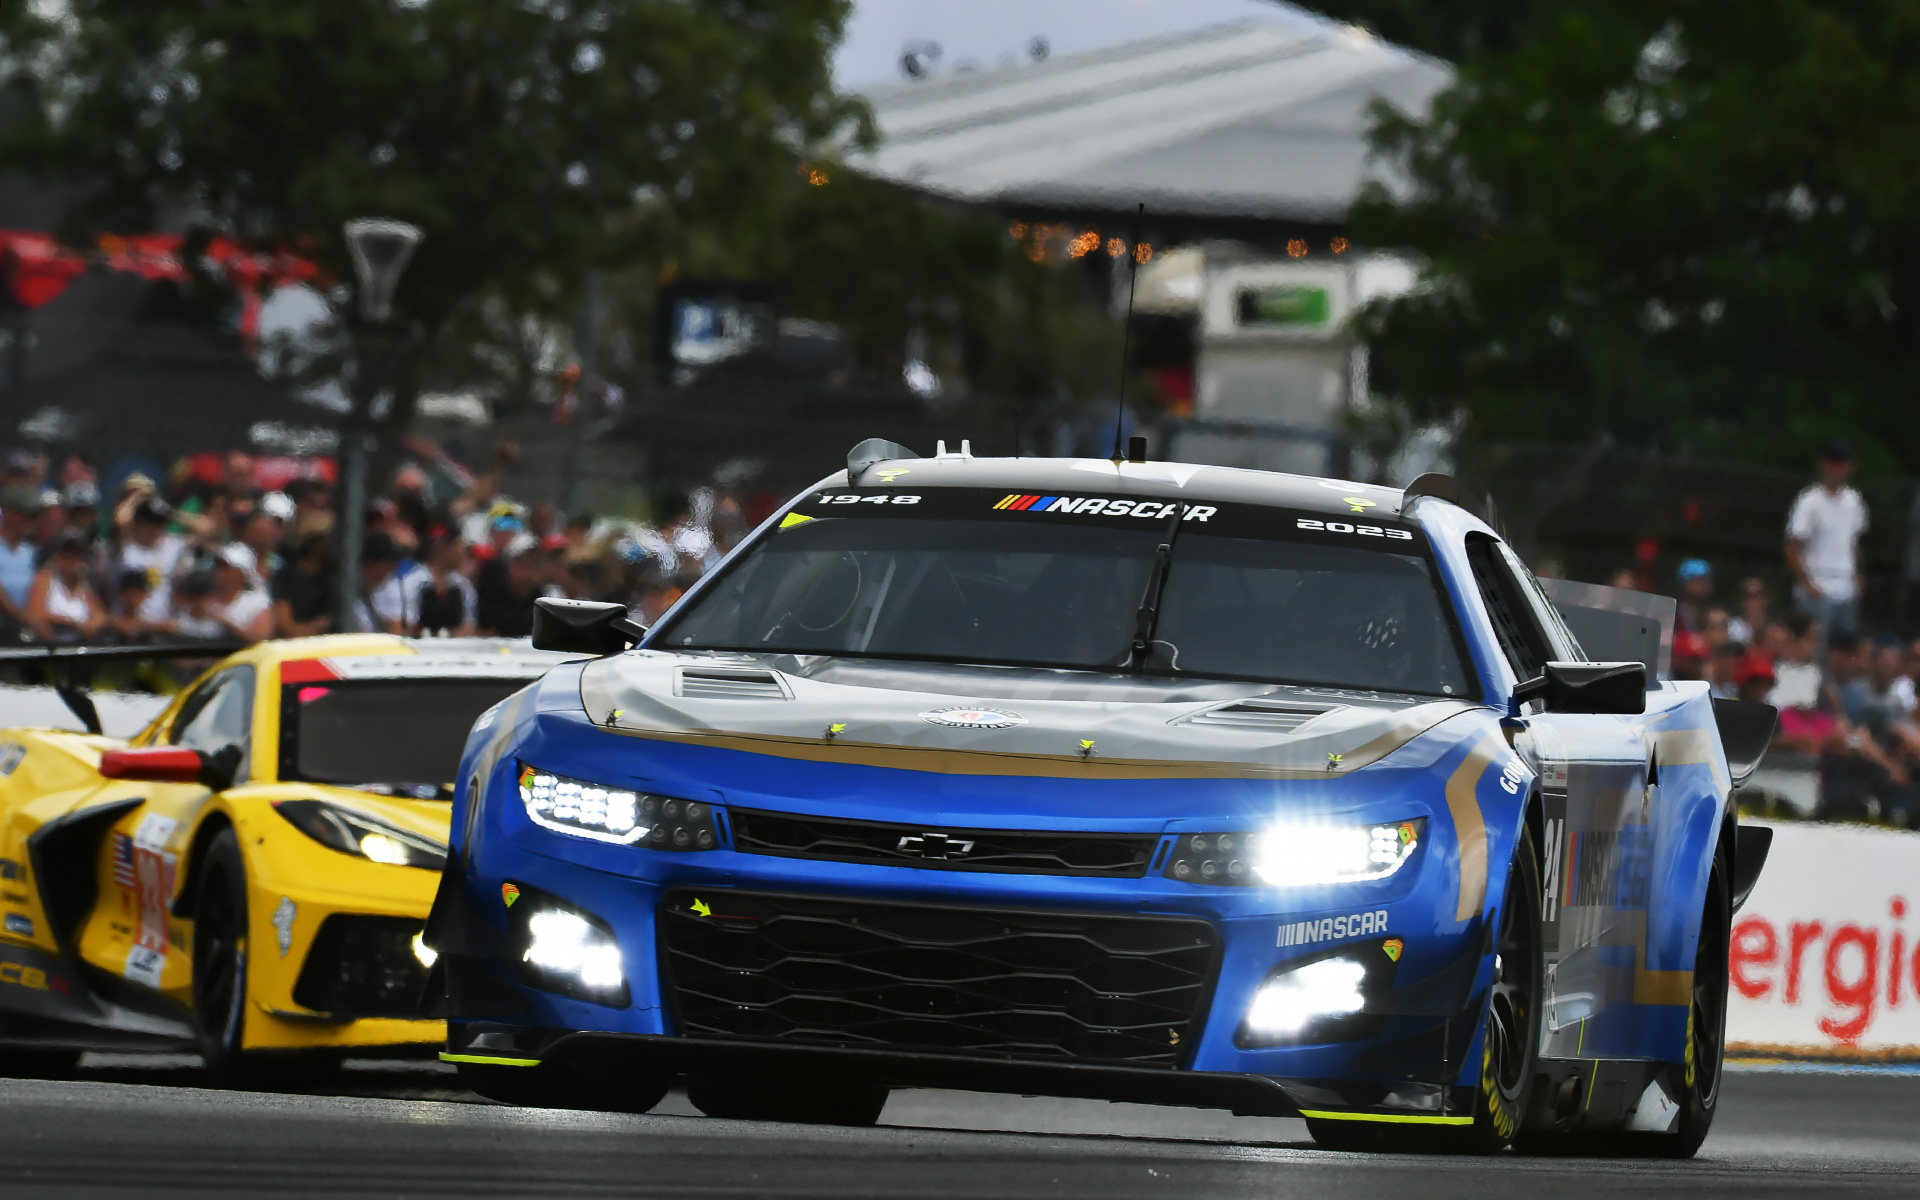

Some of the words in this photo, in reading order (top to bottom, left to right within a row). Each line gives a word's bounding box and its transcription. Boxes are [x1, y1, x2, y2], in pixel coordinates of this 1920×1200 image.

[818, 495, 922, 505] 1948
[1045, 496, 1218, 522] NASCAR
[1296, 518, 1413, 540] 2023
[1542, 818, 1564, 922] 24
[1303, 909, 1389, 944] NASCAR
[1729, 894, 1920, 1046] ergi
